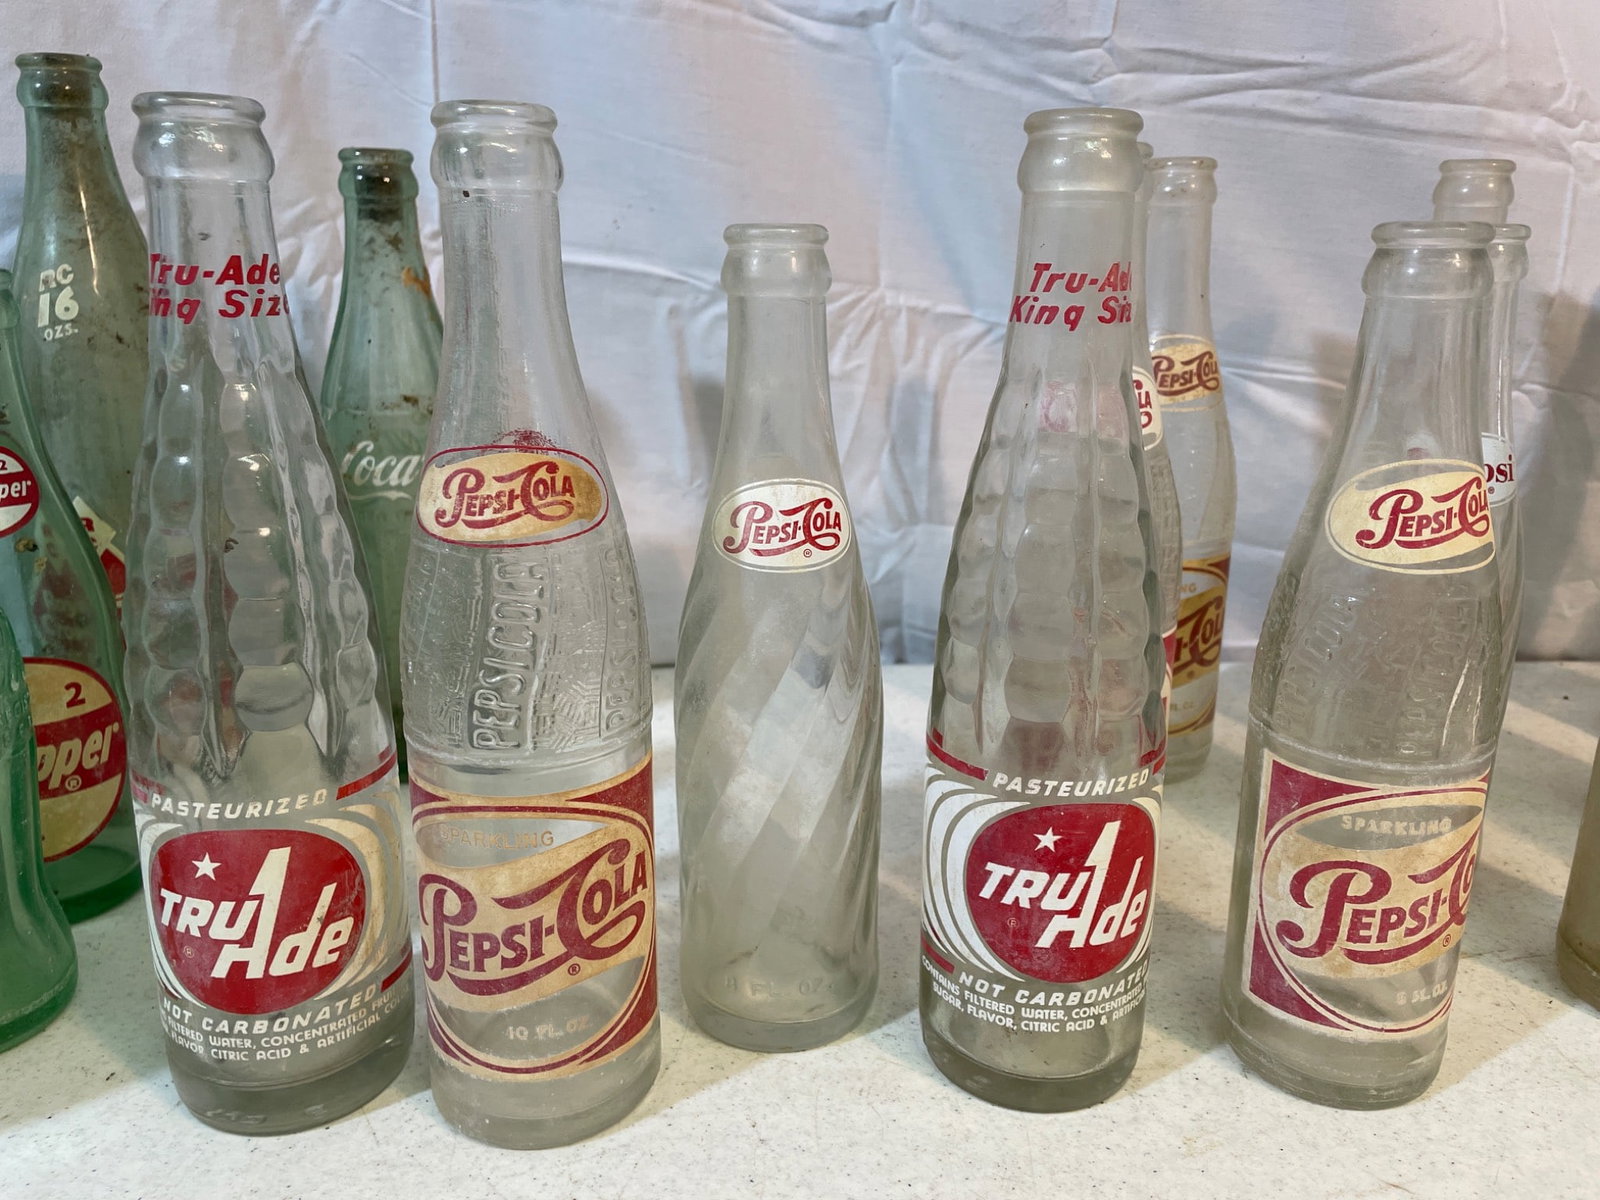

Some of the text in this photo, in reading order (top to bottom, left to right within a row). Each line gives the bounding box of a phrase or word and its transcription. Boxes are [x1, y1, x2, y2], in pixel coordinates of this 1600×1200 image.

[38, 286, 79, 328] 16
[1009, 295, 1086, 331] King
[435, 461, 575, 529] PEPSI-COLA
[723, 497, 842, 557] PEPSI-COLA
[64, 682, 86, 709] 2
[151, 788, 328, 821] PASTEURIZED
[993, 768, 1150, 798] PASTEURIZED
[440, 823, 554, 849] SPARKLING
[1341, 814, 1452, 836] SPARKLING
[978, 861, 1092, 911] TRU
[160, 887, 260, 941] TRU
[418, 838, 648, 997] PEPSI-COLA
[922, 955, 1143, 1021] CONTAINS FILTERED WATER, CONCENTRATED
[932, 981, 964, 1013] SUGAR,
[966, 1004, 1018, 1031] FLAVOR,
[1021, 1020, 1060, 1032] CITRIC
[1066, 1018, 1096, 1032] ACID
[1100, 1014, 1108, 1026] &
[959, 959, 1148, 1007] NOT CARBONATED
[163, 997, 192, 1024] NOT
[202, 983, 376, 1035] CARBONATED
[168, 1015, 203, 1042] FILTERED
[209, 1035, 257, 1050] WATER,
[261, 1008, 367, 1048] CONCENTRATED
[210, 1048, 250, 1061] CITRIC
[256, 1046, 292, 1061] ACID
[299, 1043, 310, 1054] &
[317, 1012, 381, 1049] ARTIFICIAL
